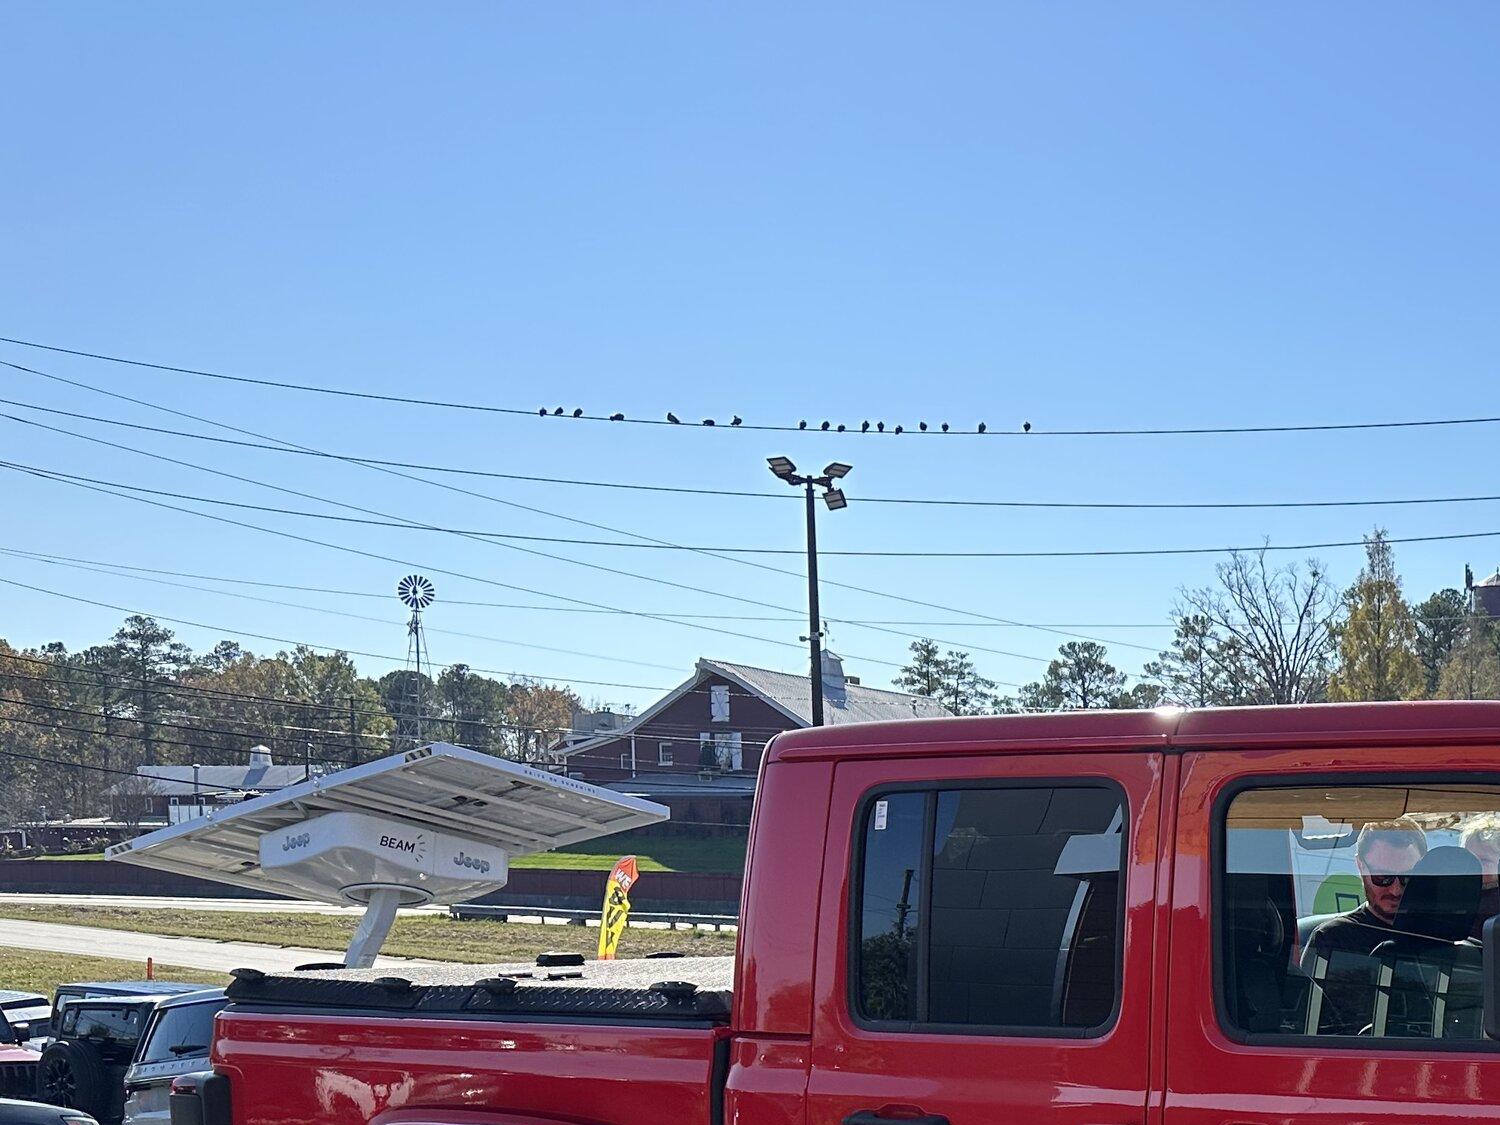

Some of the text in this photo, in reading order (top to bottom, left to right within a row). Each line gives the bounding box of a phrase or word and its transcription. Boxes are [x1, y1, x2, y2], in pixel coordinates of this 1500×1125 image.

[282, 832, 311, 852] Jeep
[380, 835, 416, 853] BEAM
[453, 852, 491, 874] Jeep
